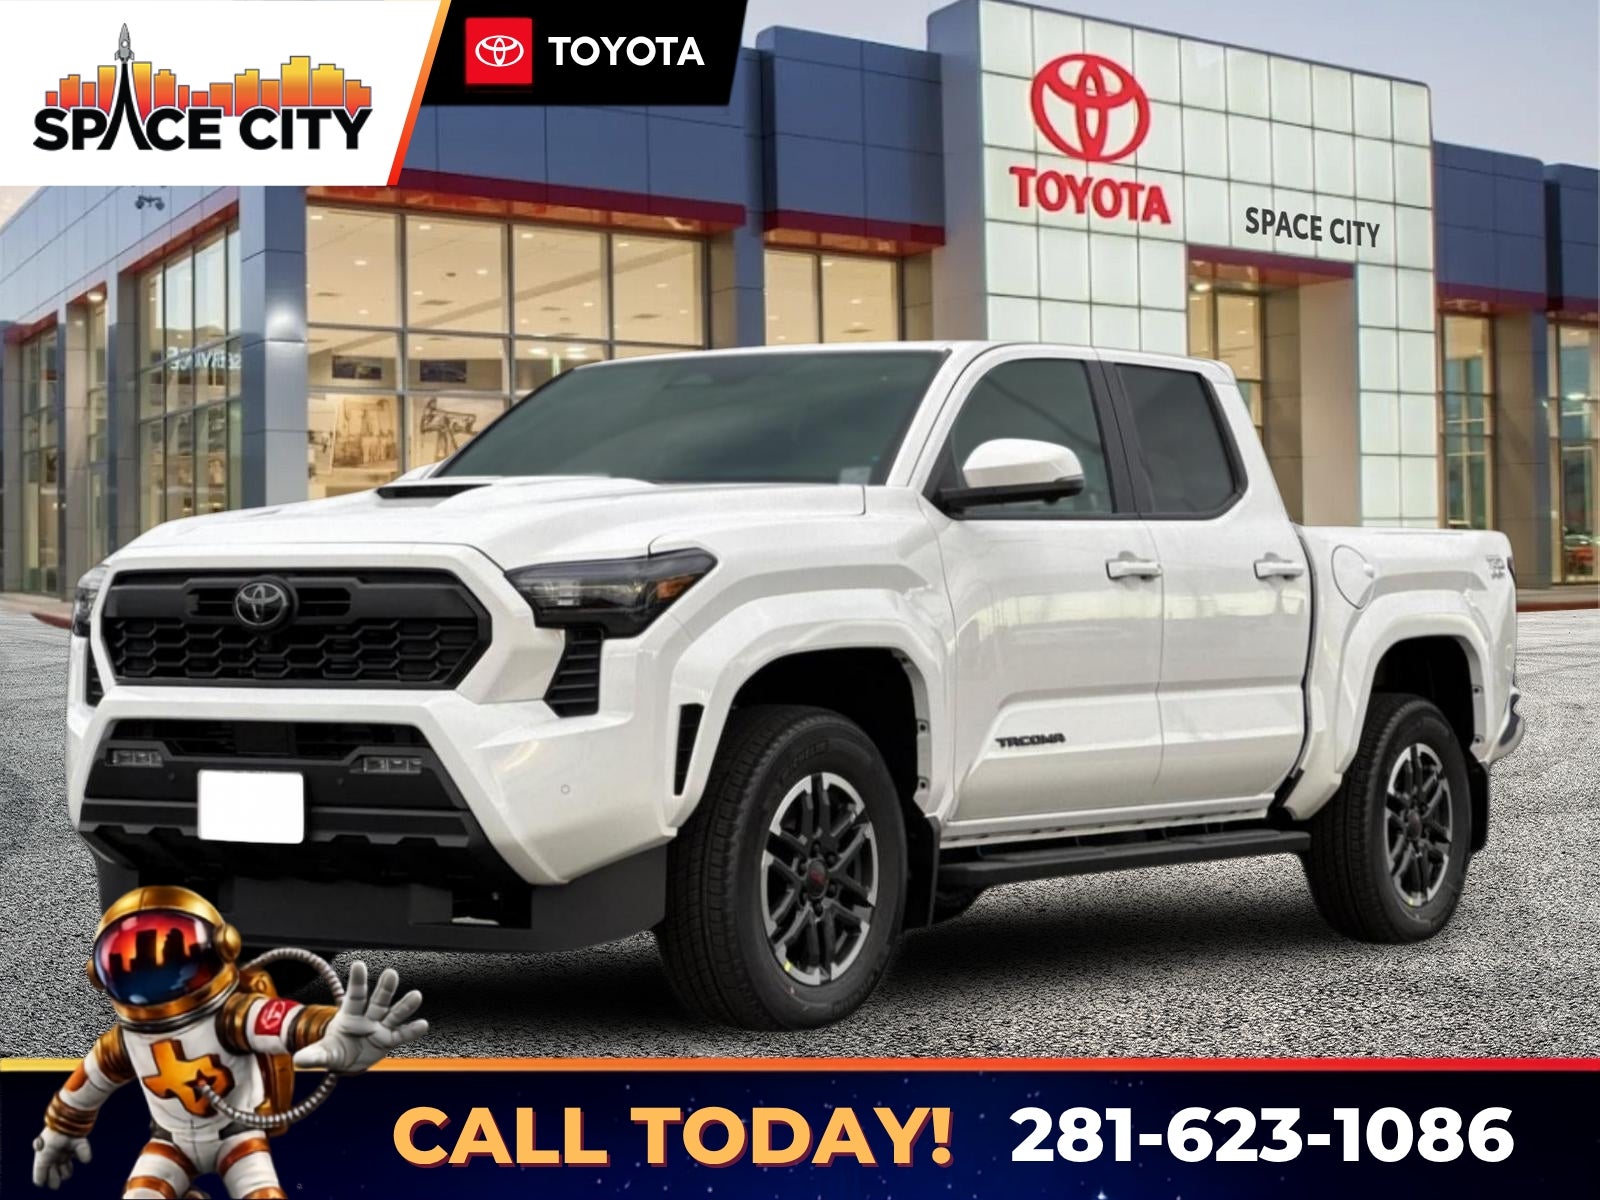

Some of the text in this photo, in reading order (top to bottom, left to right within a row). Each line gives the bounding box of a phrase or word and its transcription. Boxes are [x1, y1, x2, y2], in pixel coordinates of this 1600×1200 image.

[1010, 166, 1171, 224] TOYOTA
[1245, 206, 1381, 248] SPACE CITY
[995, 732, 1066, 748] TACOMA
